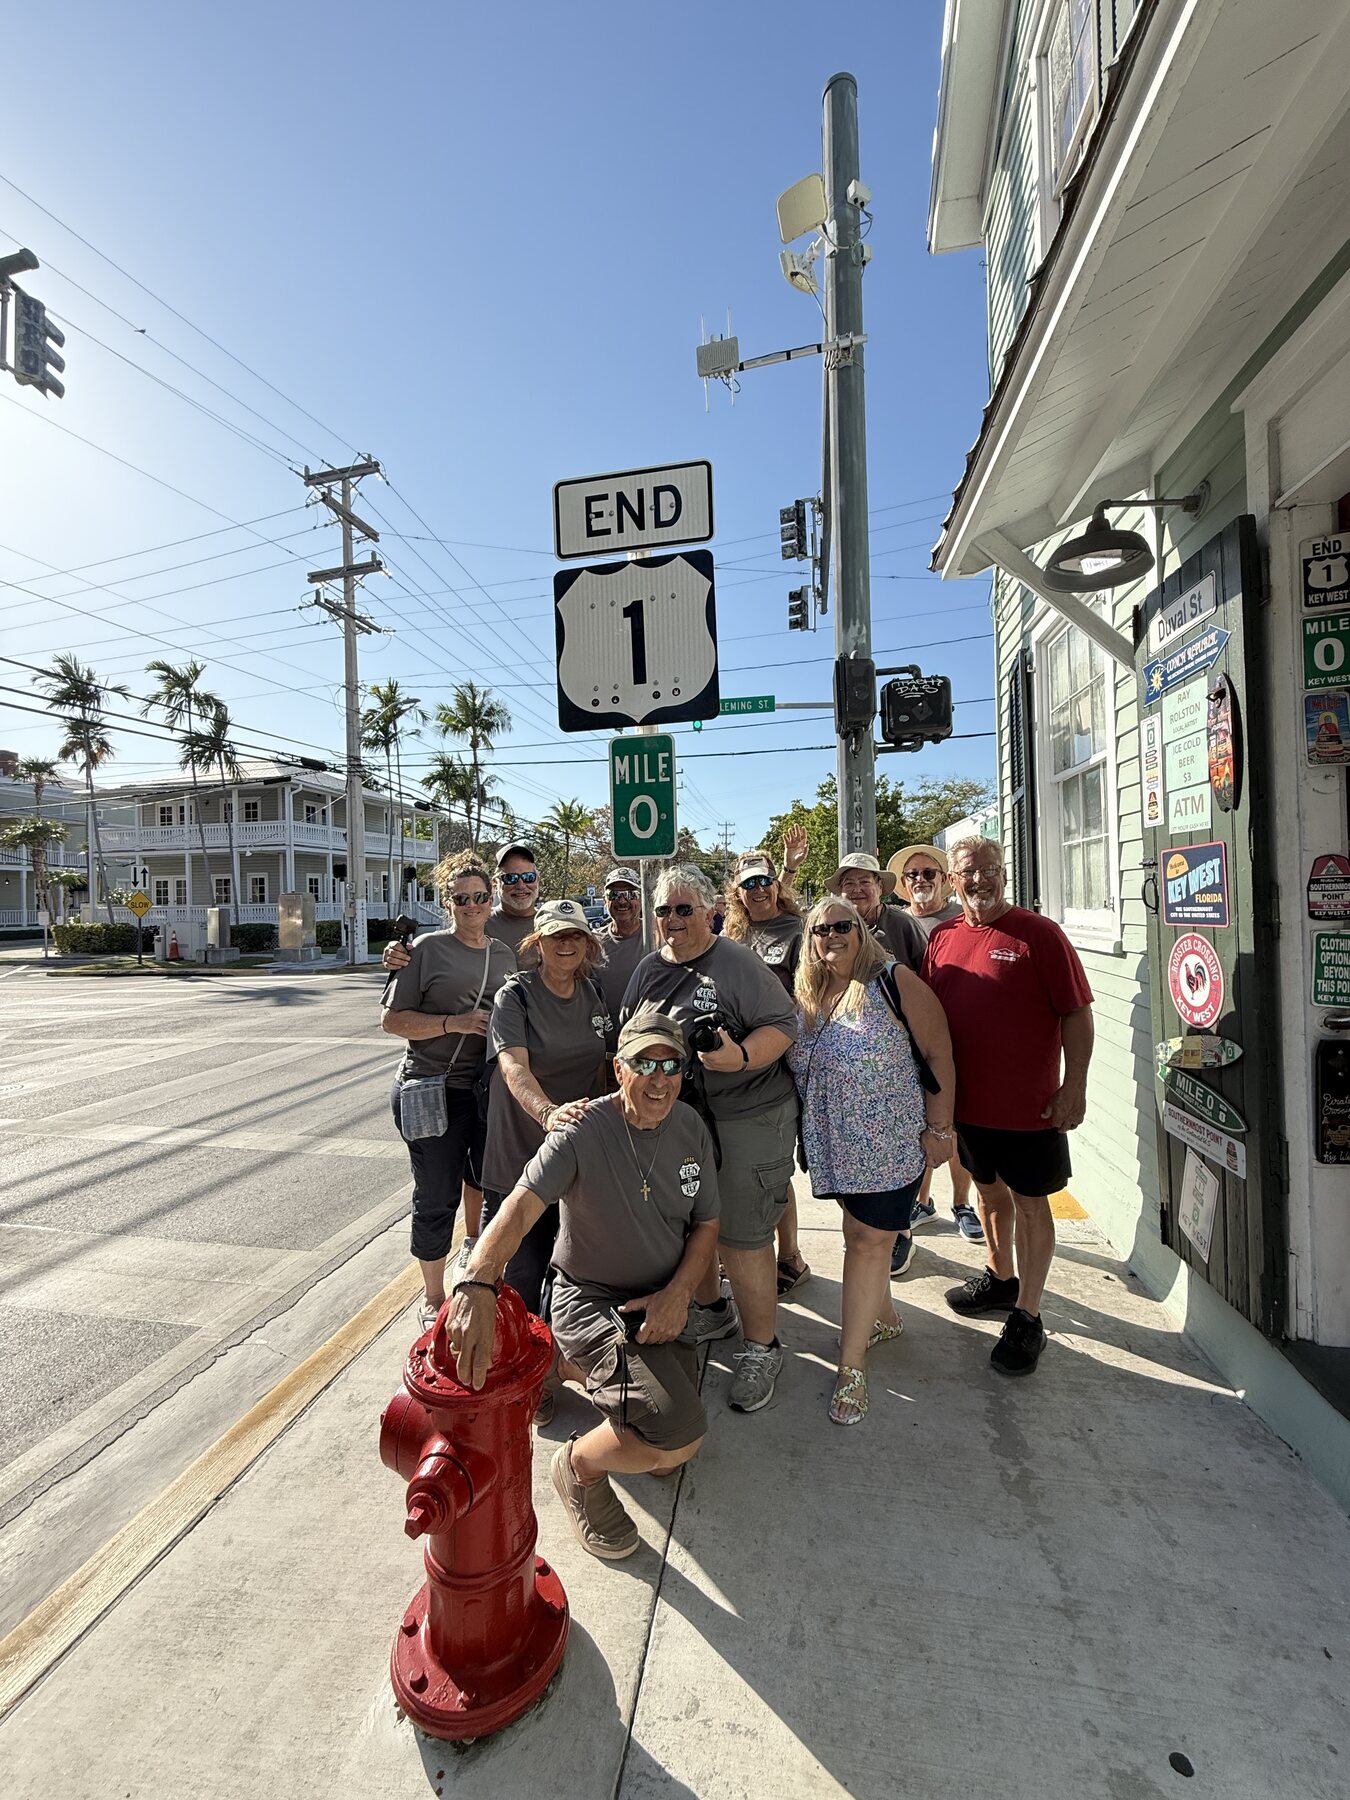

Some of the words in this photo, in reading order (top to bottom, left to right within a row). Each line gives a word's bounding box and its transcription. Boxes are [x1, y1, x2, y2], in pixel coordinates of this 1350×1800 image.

[585, 484, 682, 538] END
[1312, 540, 1342, 556] END
[1322, 564, 1332, 582] 1
[1308, 592, 1325, 604] KEY
[1326, 590, 1349, 602] WEST
[1158, 601, 1187, 642] Duval
[1190, 590, 1203, 617] St
[1306, 618, 1350, 634] MILE
[623, 599, 647, 685] 1
[1314, 638, 1345, 671] 0
[1308, 678, 1326, 686] KEY
[1327, 675, 1350, 685] WEST
[1177, 689, 1191, 704] RAY
[719, 701, 752, 712] LEMING
[1169, 701, 1201, 724] ROLSTON
[1172, 742, 1182, 755] ICE
[1183, 736, 1201, 751] COLD
[615, 752, 670, 785] MILE
[1179, 755, 1195, 769] BEER
[1183, 771, 1192, 783] $3
[1173, 793, 1205, 819] ATM
[629, 795, 659, 838] 0
[1167, 874, 1188, 904] KEY
[1188, 858, 1221, 895] WEST
[1195, 893, 1223, 903] FLORIDA
[1322, 892, 1345, 901] POINT
[1171, 939, 1193, 973] ROOSTER
[1193, 939, 1219, 981] CROSSING
[1317, 979, 1336, 993] THIS
[1336, 980, 1350, 994] POI
[1317, 994, 1335, 1002] KEY
[1176, 995, 1192, 1018] KEY
[1192, 1002, 1215, 1023] WEST
[1176, 1073, 1204, 1103] MILE
[1168, 1107, 1206, 1137] SOUTHERNMOST
[1206, 1127, 1223, 1146] POINT
